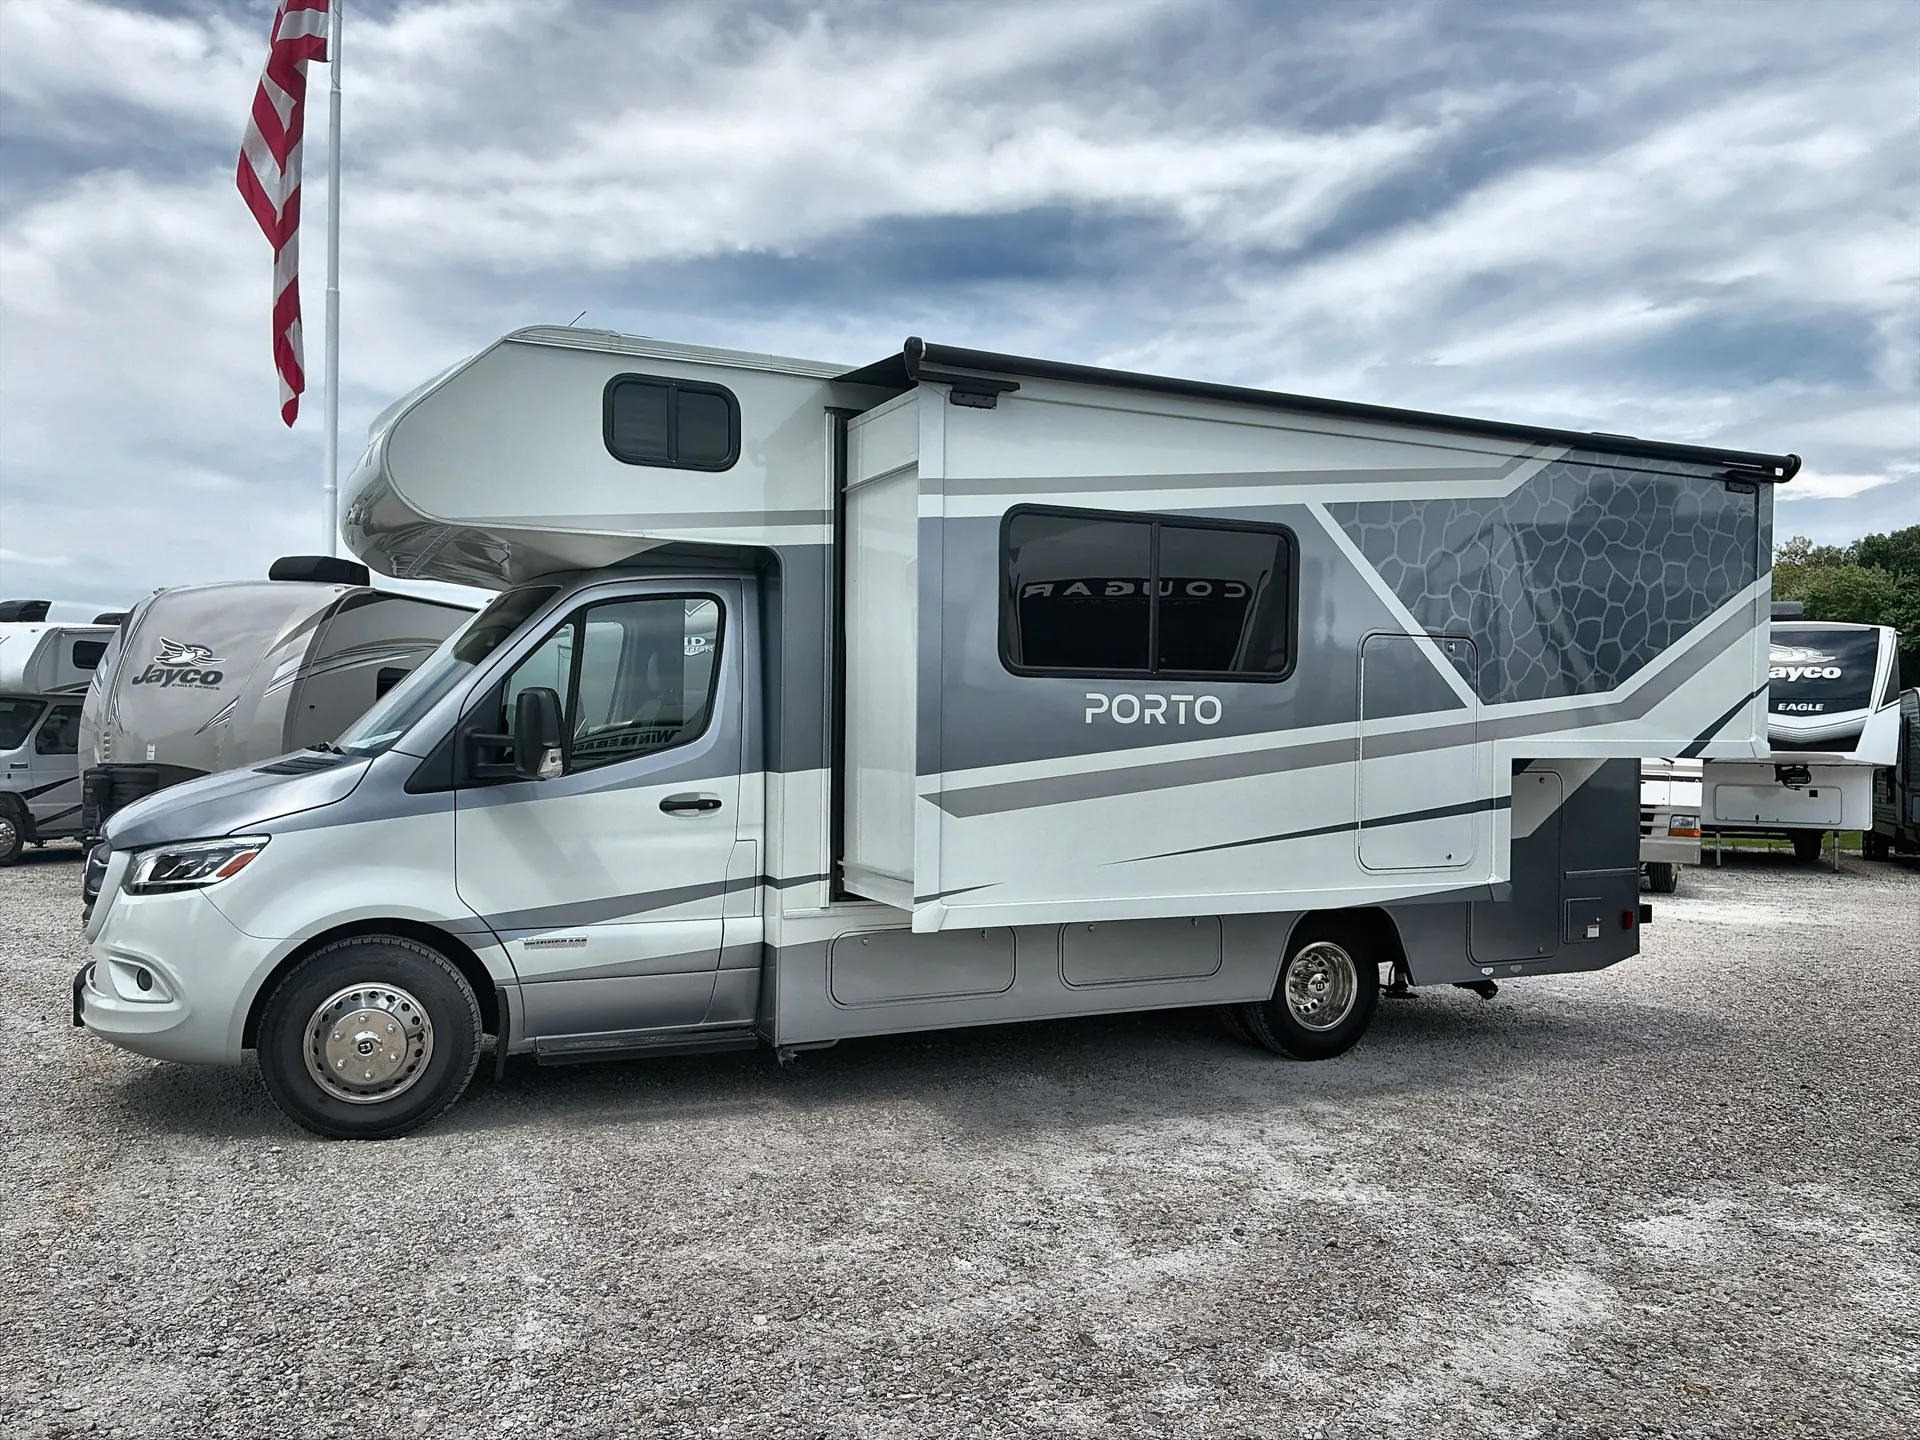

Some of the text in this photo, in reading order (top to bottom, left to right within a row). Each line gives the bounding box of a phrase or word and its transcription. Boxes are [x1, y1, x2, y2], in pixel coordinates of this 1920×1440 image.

[132, 664, 224, 688] Jayco
[1769, 664, 1842, 682] ayco
[1085, 692, 1222, 725] PORTO
[1777, 703, 1825, 711] EAGLE
